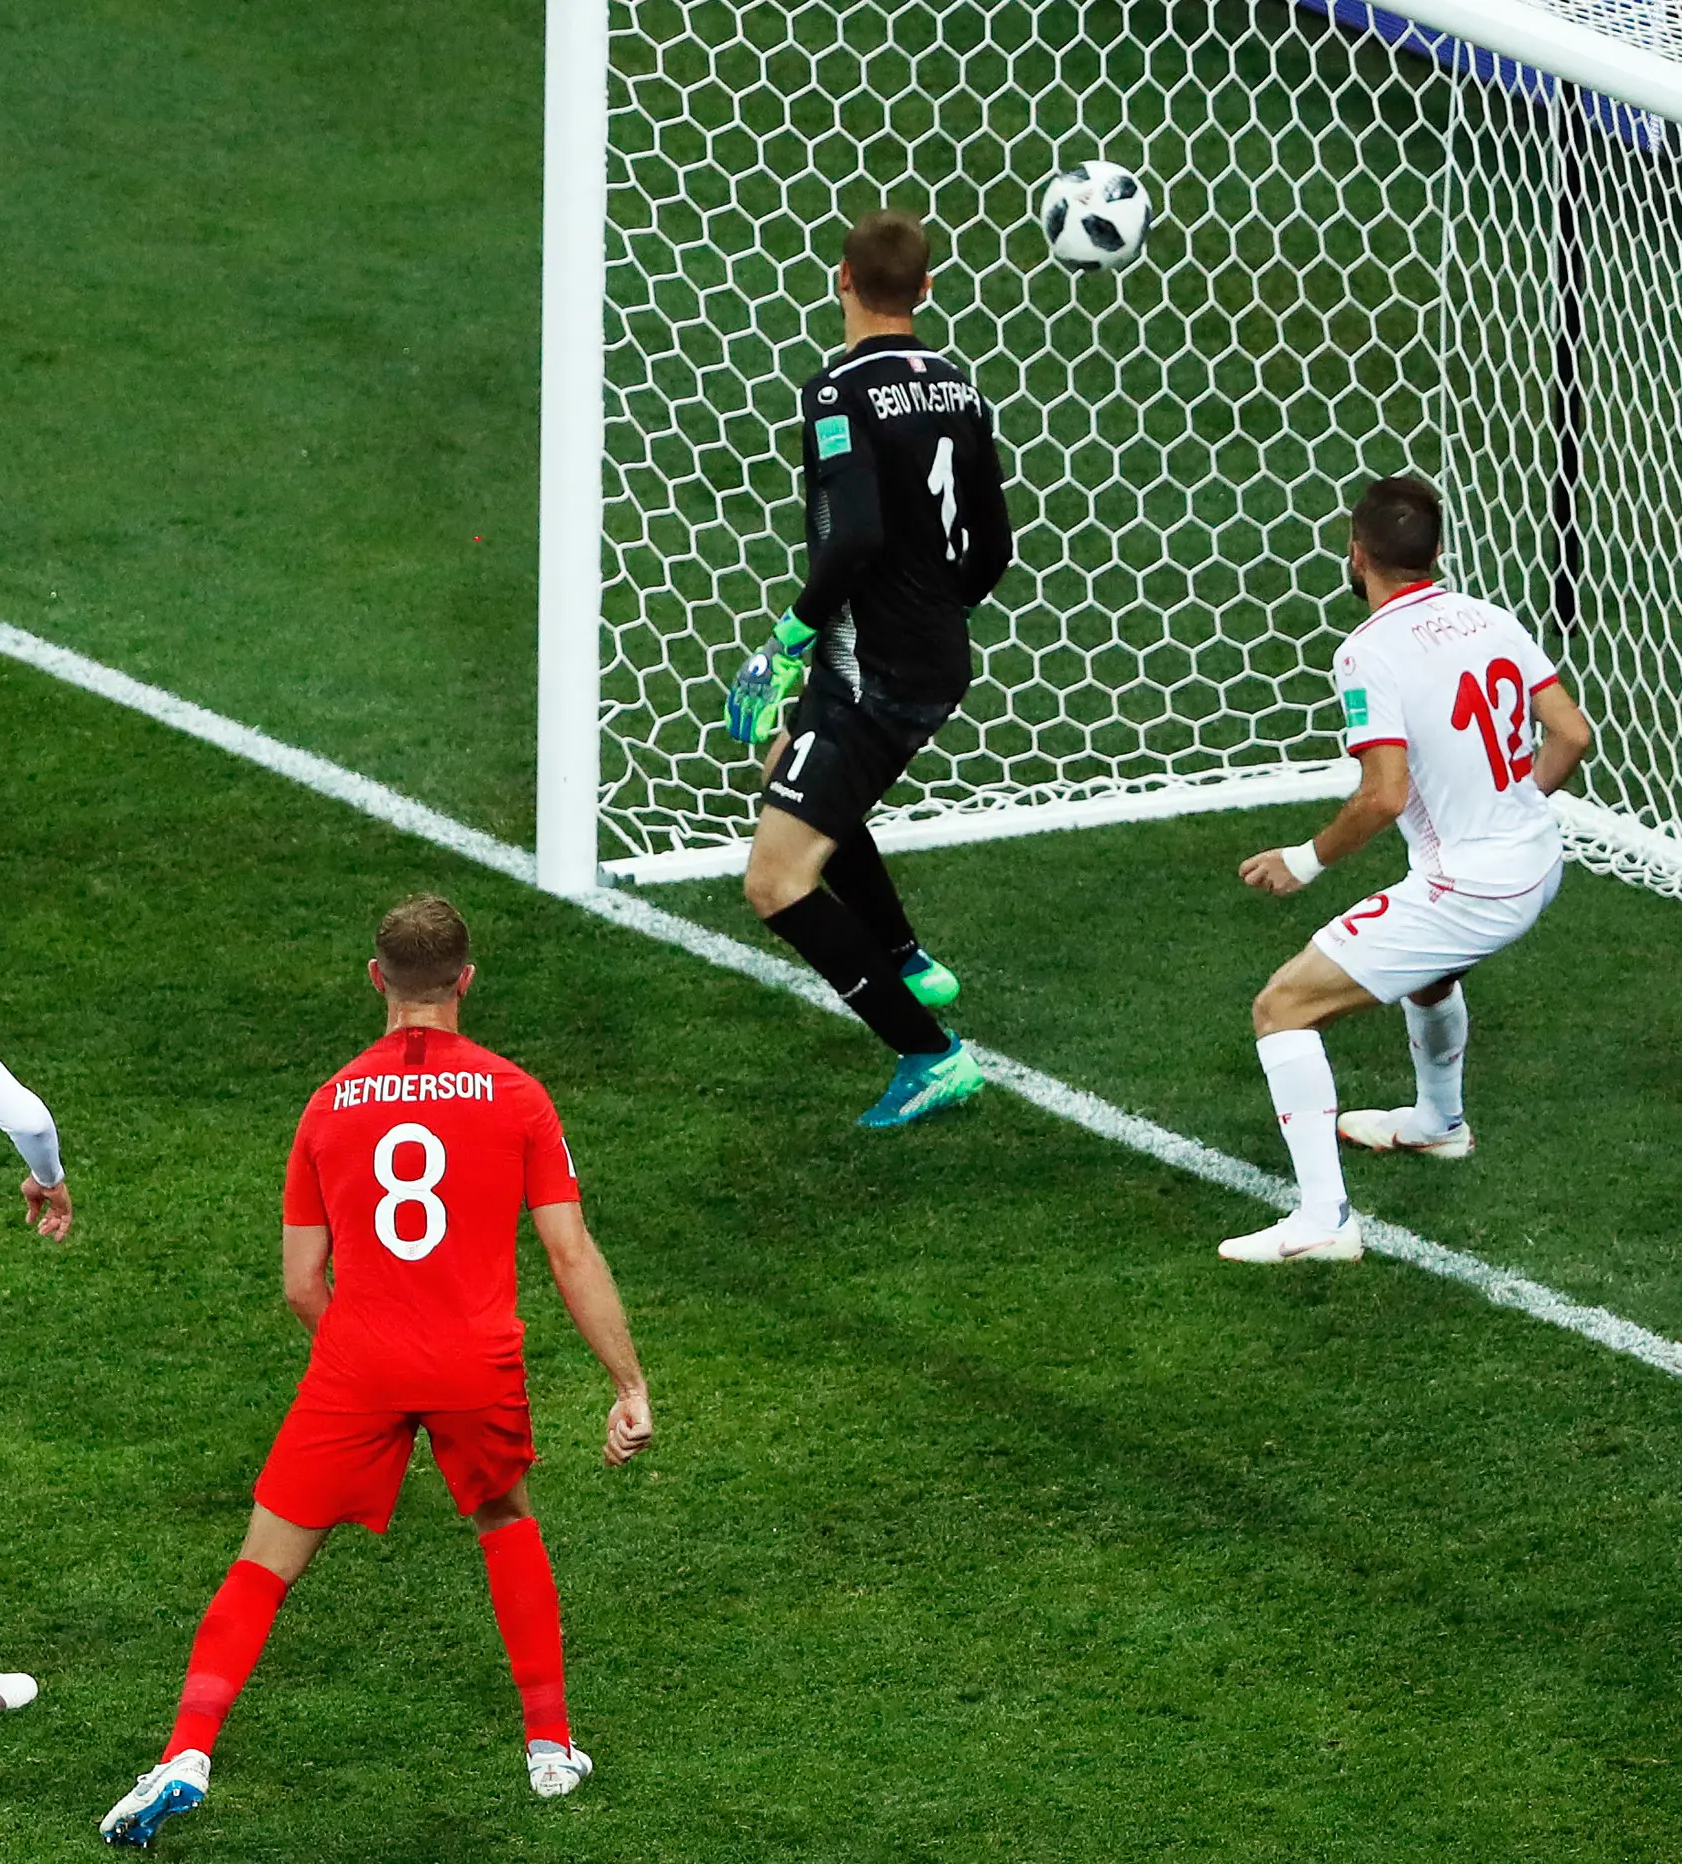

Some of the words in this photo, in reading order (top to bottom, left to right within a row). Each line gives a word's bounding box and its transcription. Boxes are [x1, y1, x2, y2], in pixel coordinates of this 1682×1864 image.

[867, 386, 911, 420] BEN
[1450, 657, 1533, 792] 12
[787, 730, 816, 781] 1
[332, 1071, 494, 1111] HENDERSON
[373, 1122, 448, 1261] 8
